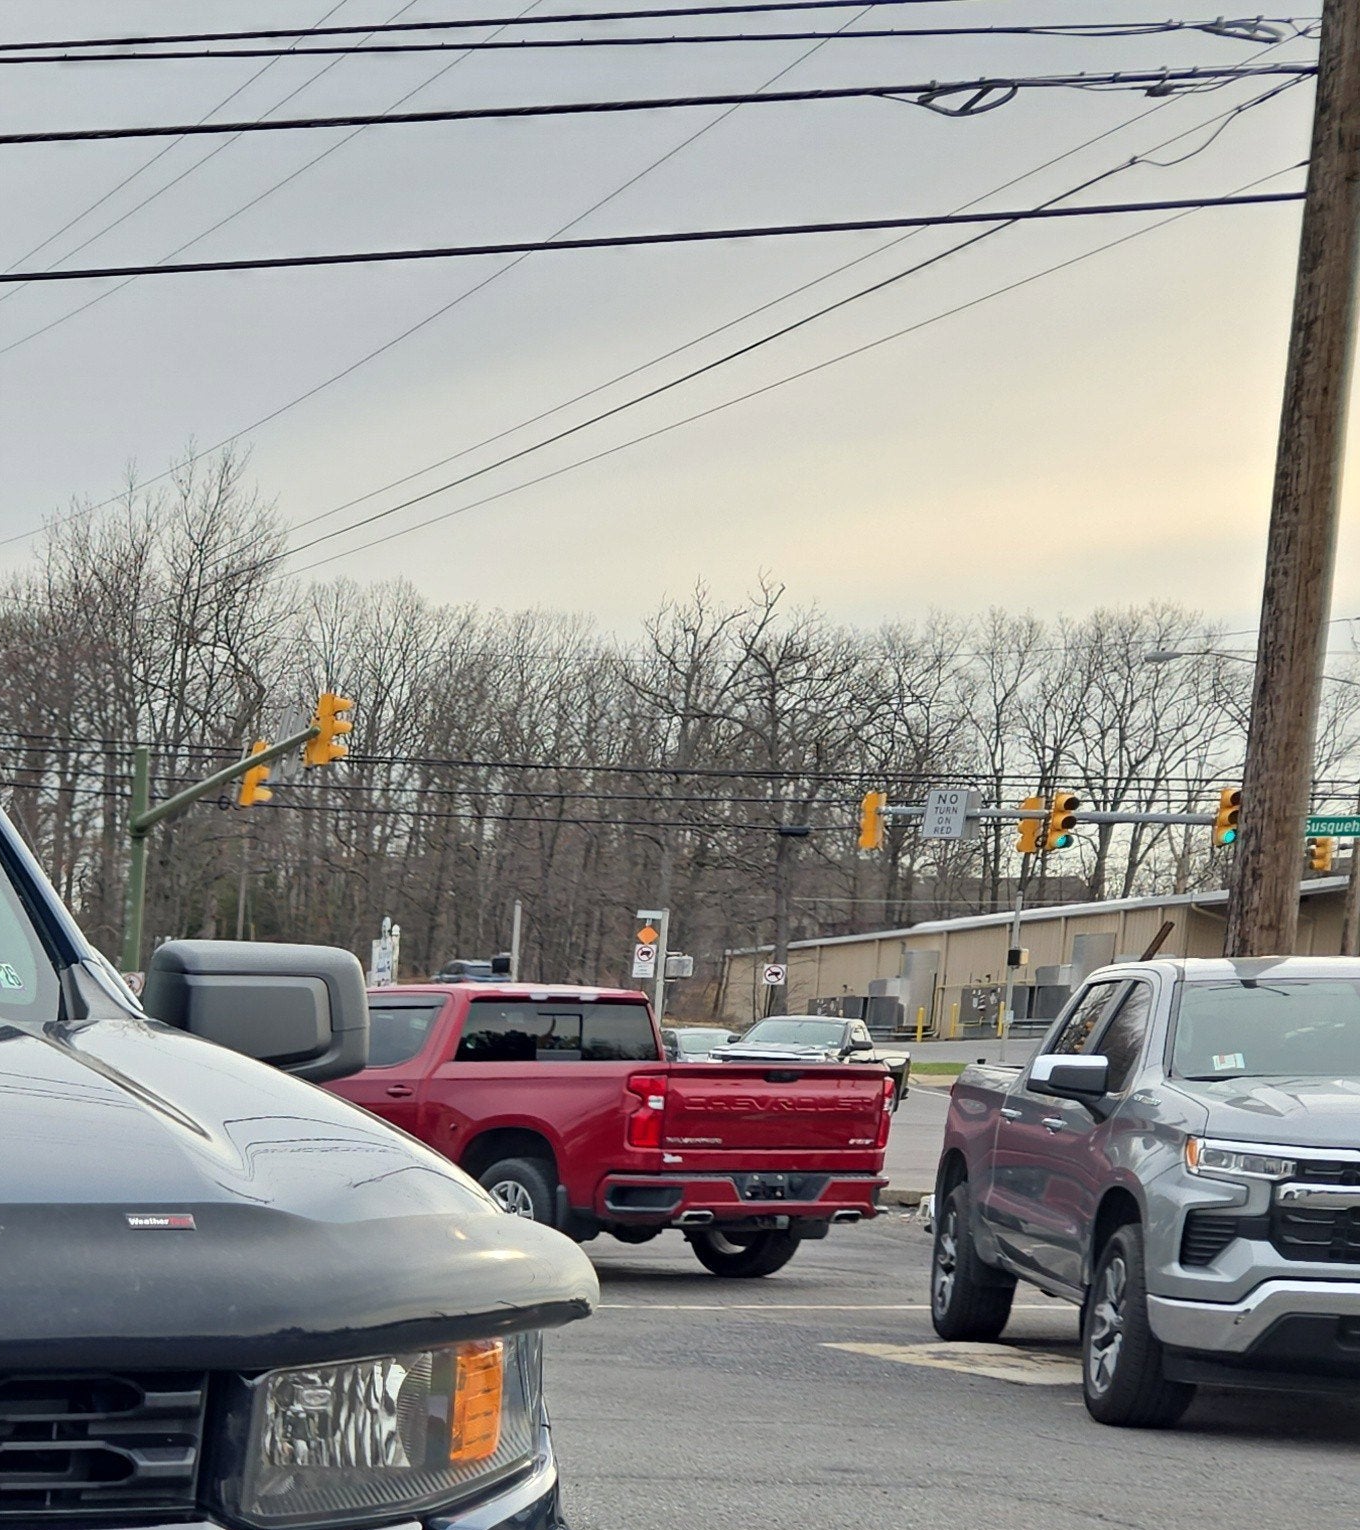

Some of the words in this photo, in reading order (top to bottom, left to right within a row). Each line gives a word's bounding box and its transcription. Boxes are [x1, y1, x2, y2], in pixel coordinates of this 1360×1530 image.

[937, 794, 959, 805] NO
[934, 806, 959, 815] TURN
[937, 816, 951, 825] ON
[933, 826, 952, 835] RED
[684, 1097, 874, 1111] CHEVROLET
